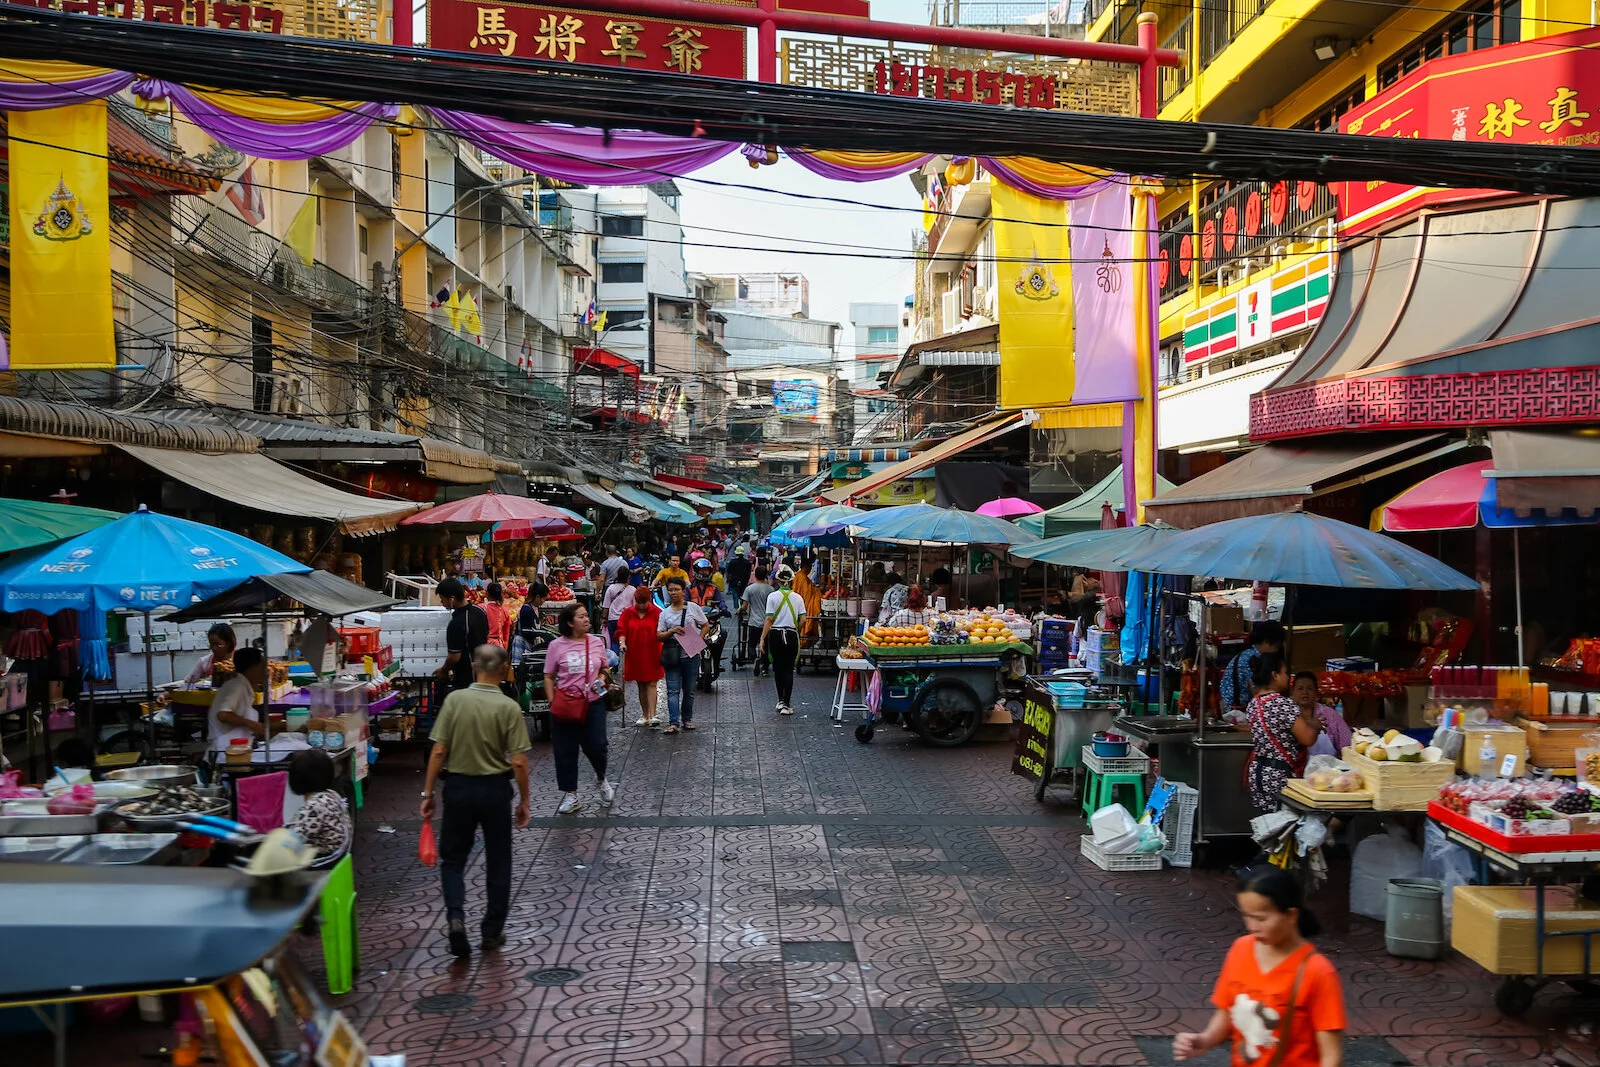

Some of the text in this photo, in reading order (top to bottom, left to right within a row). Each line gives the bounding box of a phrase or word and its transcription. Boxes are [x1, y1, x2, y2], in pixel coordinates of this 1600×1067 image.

[469, 7, 709, 75] 馬將軍爺
[40, 564, 92, 572] NEXT
[192, 557, 239, 570] NEXT
[140, 589, 179, 601] NEXT
